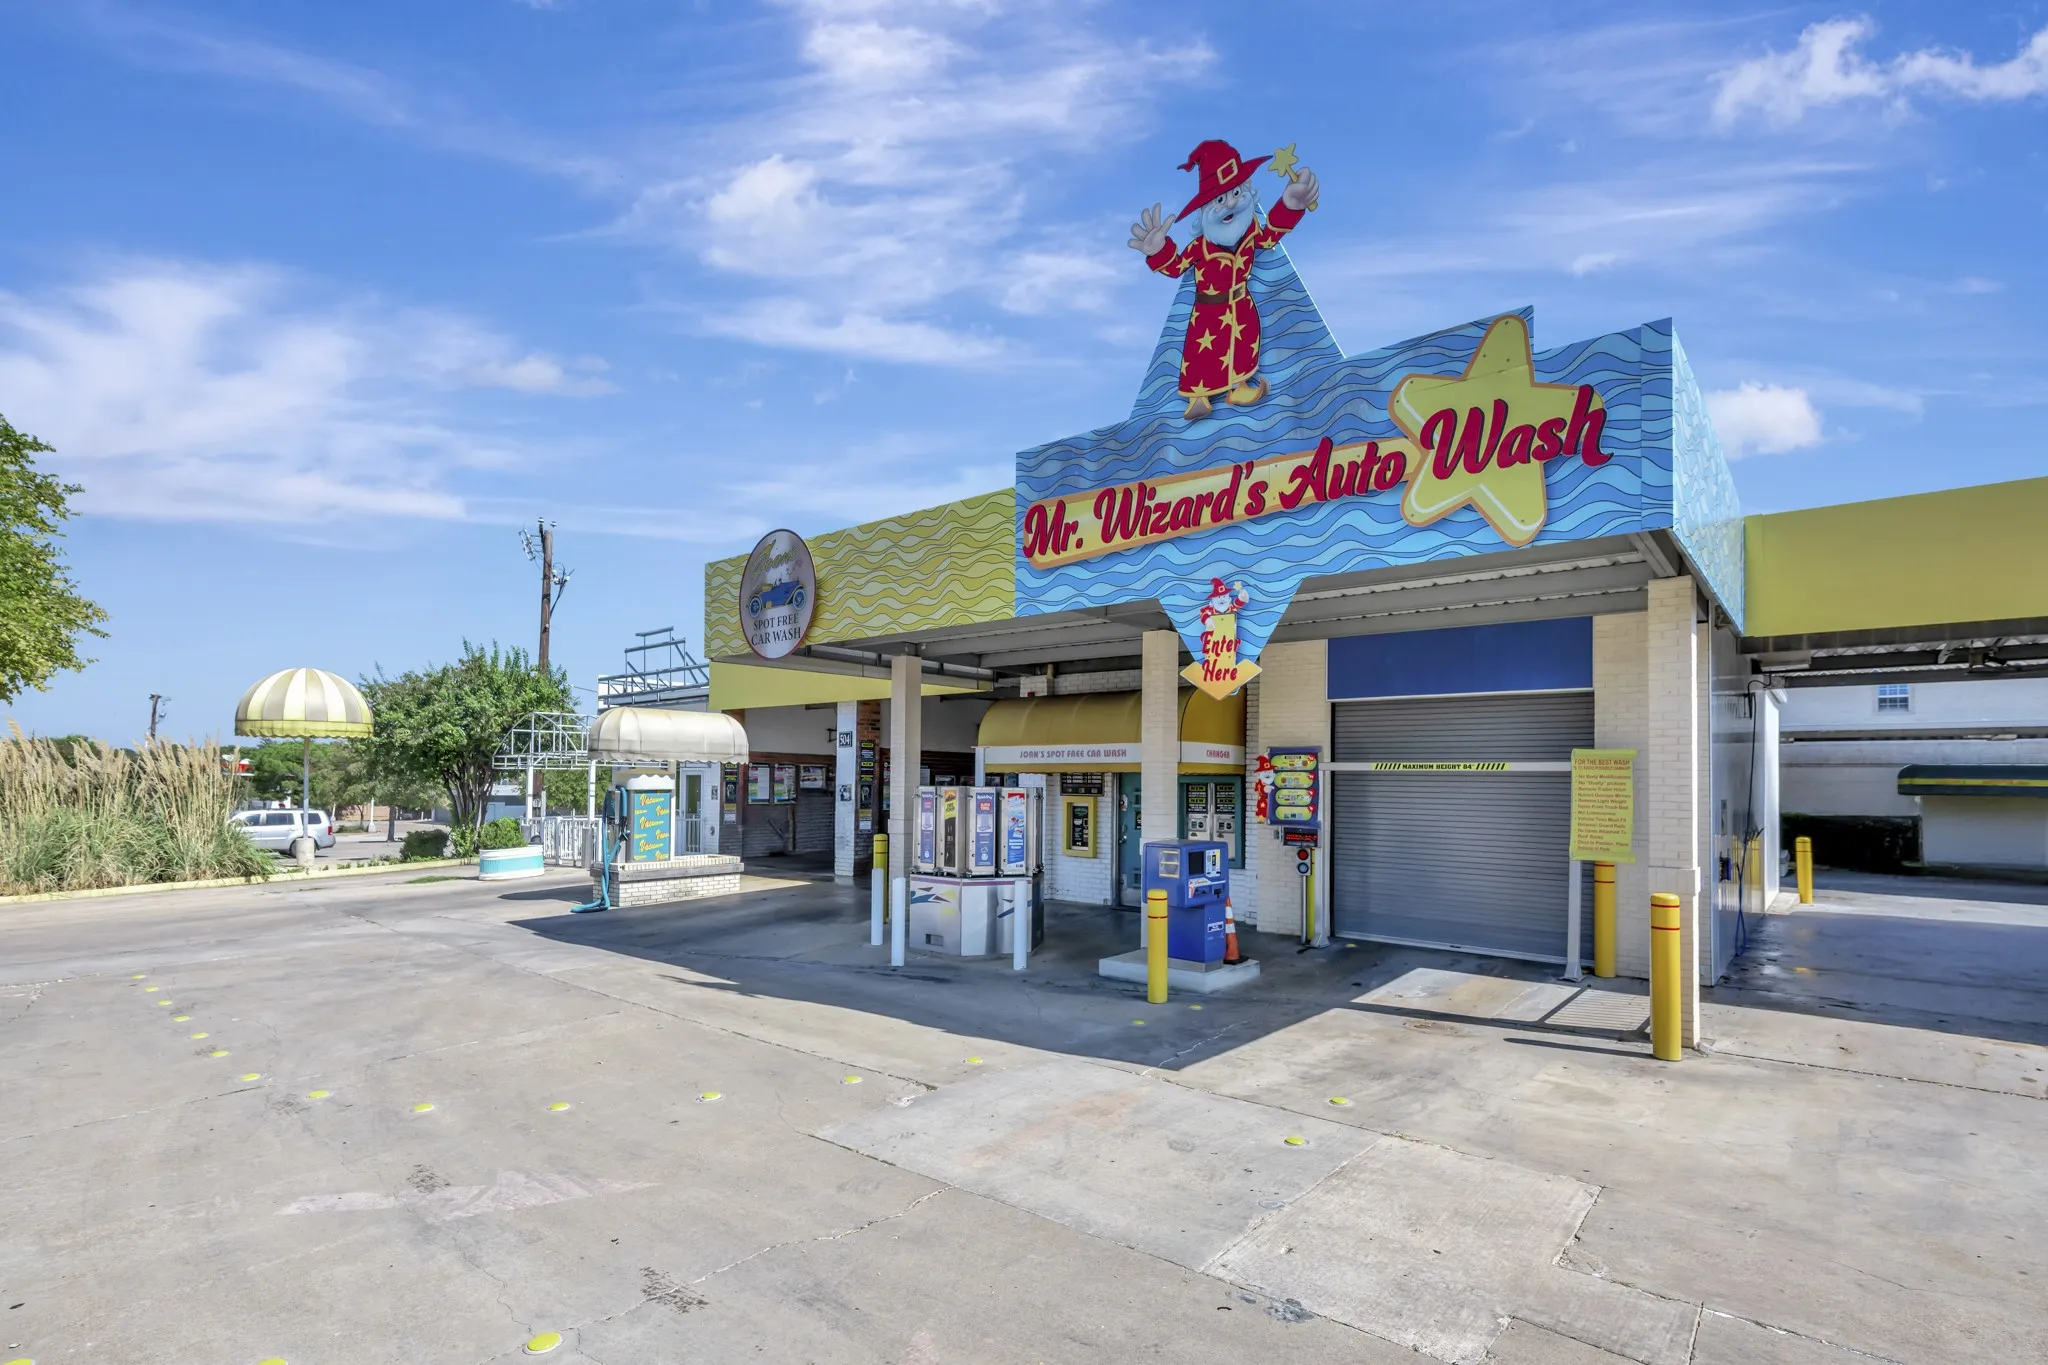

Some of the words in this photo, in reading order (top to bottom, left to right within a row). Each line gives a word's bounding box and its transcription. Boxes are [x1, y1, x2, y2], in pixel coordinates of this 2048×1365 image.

[1023, 500, 1083, 558] Mr.
[1093, 461, 1268, 544] Wizard's
[1279, 437, 1406, 509] Auto
[1420, 384, 1613, 480] Wash
[753, 617, 775, 631] SPOT
[777, 613, 799, 626] FREE
[751, 632, 771, 646] CAR
[772, 627, 801, 643] WASH
[1201, 631, 1241, 657] Enter
[1202, 659, 1238, 682] Here
[840, 734, 851, 745] 504
[1019, 750, 1045, 758] JOAN'S
[1047, 750, 1065, 758] SPOT
[1067, 750, 1084, 758] FREE
[1087, 750, 1101, 758] CAR
[1104, 749, 1127, 758] WASH
